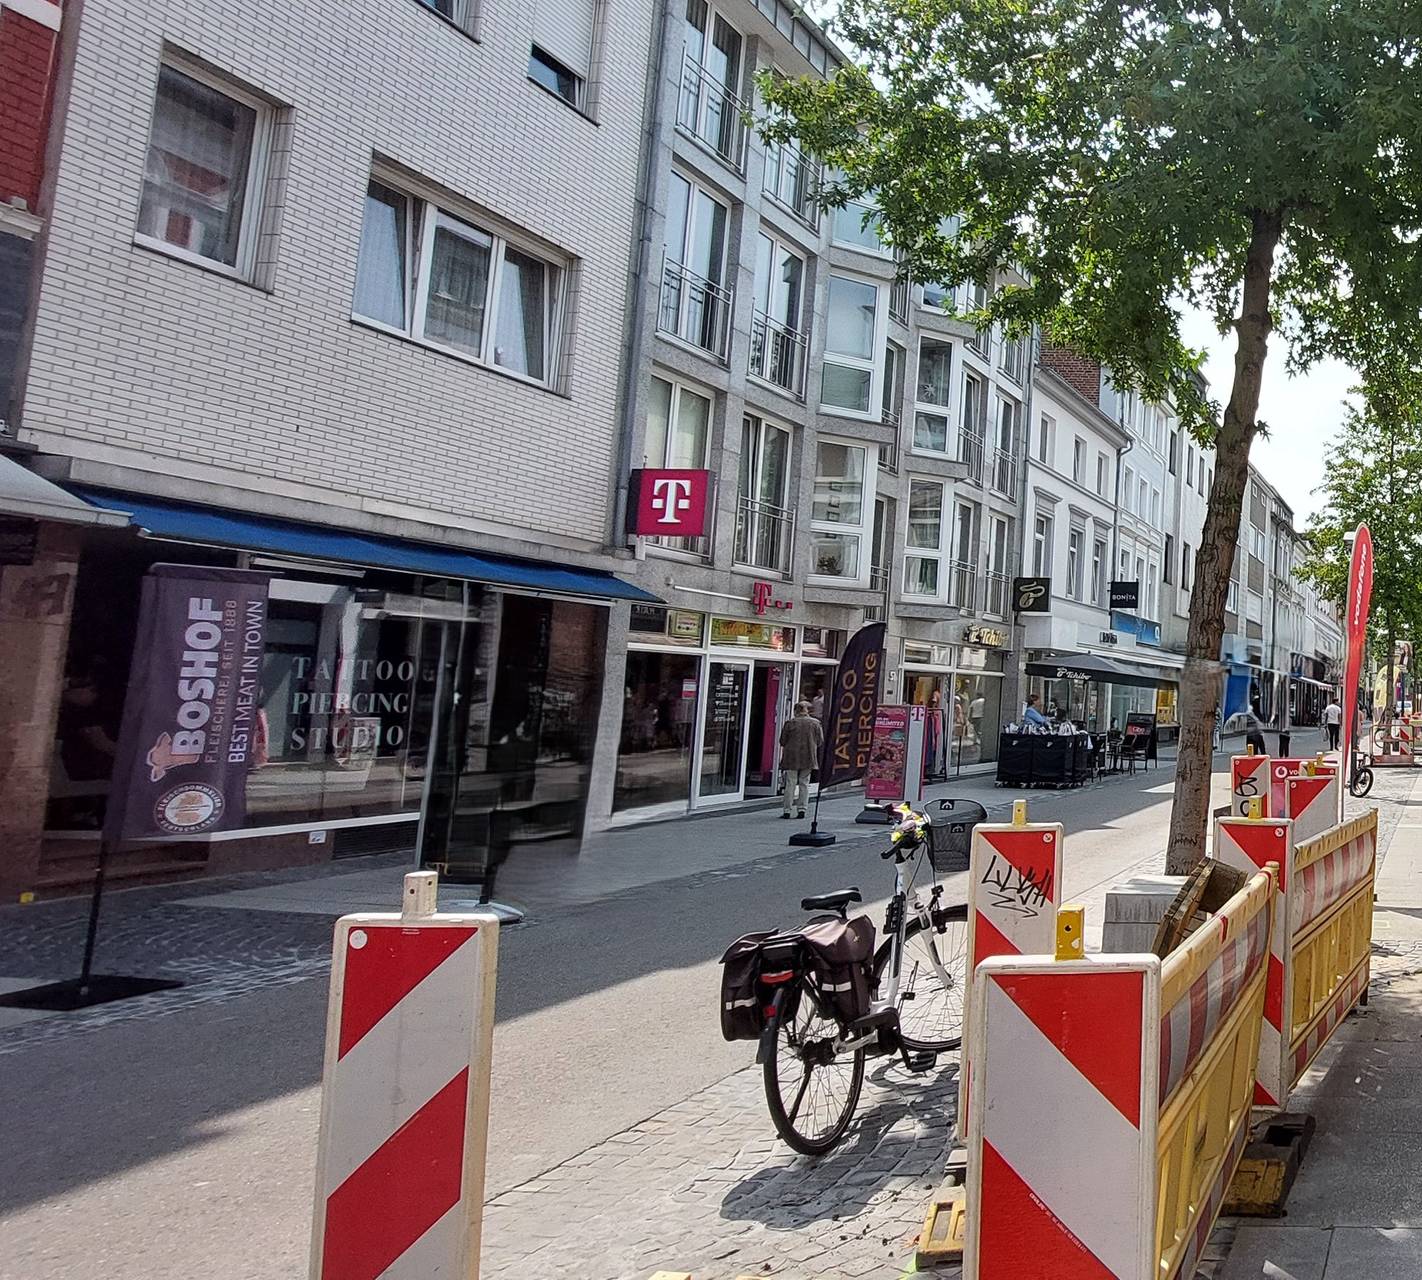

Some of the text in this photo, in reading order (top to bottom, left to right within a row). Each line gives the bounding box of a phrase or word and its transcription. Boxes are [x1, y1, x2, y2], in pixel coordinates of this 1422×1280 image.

[1354, 543, 1367, 625] vodafone
[171, 597, 223, 755] BOSHOF
[204, 599, 238, 763] FLEISCHEREI SEIT 1888
[228, 600, 264, 763] BEST MEAT IN TOWN
[289, 692, 409, 715] PIERCING
[292, 656, 415, 681] TATTOO
[856, 652, 878, 768] PIERCING
[1066, 671, 1092, 680] Tchibo
[290, 725, 404, 751] STUDIO
[832, 669, 857, 775] TATTOO
